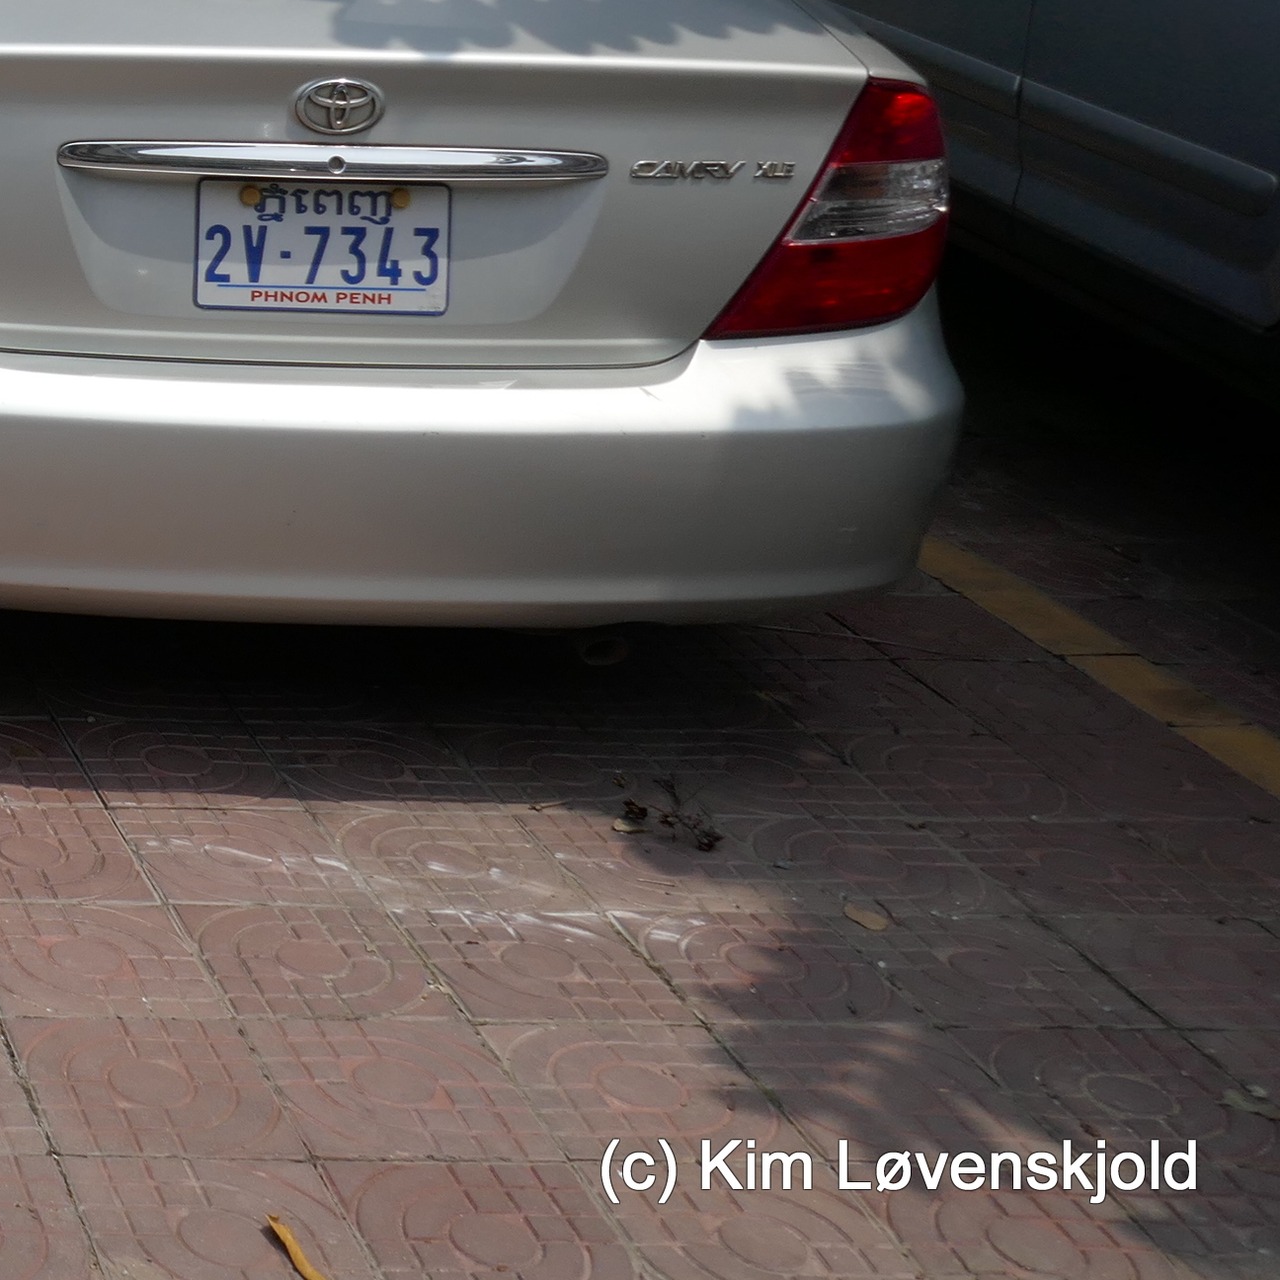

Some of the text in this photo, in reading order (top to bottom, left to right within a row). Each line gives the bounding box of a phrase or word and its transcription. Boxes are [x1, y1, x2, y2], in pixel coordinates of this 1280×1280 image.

[629, 160, 797, 180] CAMRY XLE
[204, 223, 440, 286] 2V-7343
[250, 290, 393, 305] PHNOM PENH
